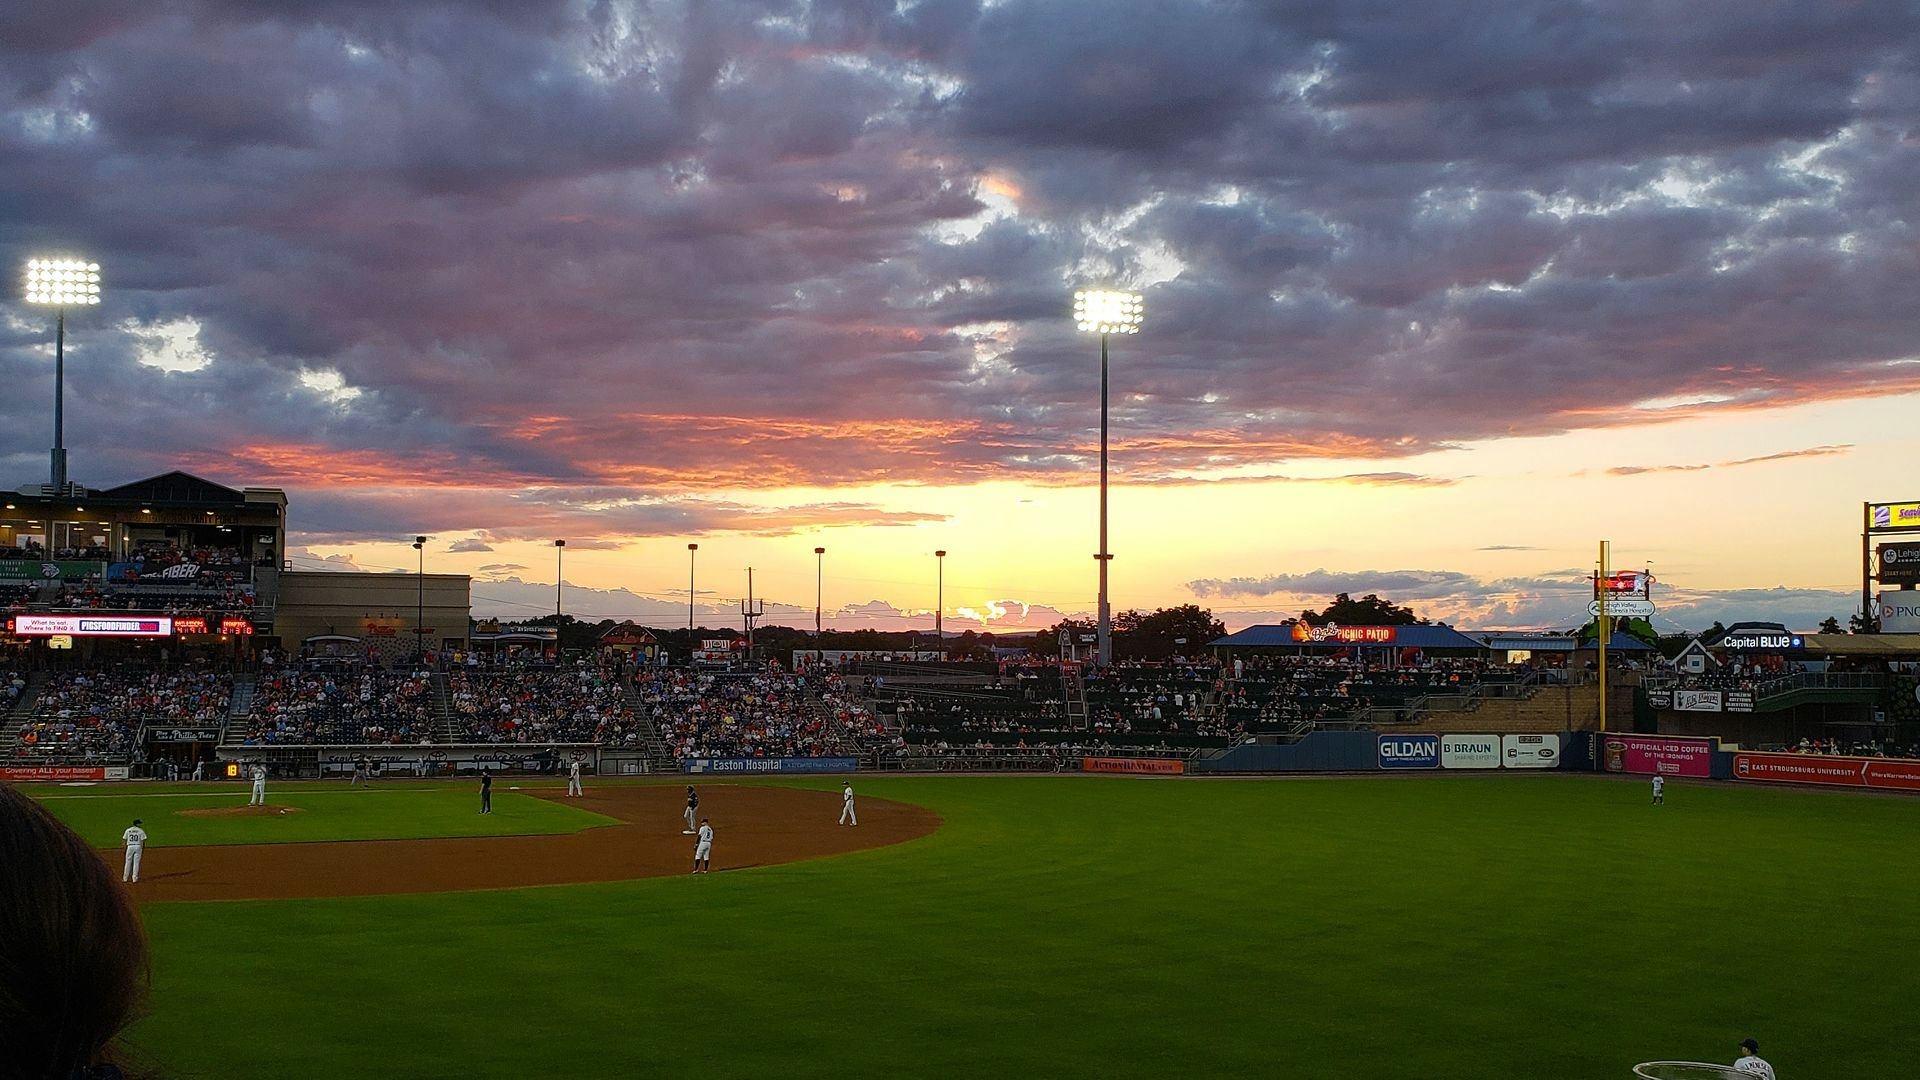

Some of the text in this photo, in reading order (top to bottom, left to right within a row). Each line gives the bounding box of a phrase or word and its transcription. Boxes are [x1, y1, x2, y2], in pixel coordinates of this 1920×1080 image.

[162, 564, 200, 579] FIBER!
[7, 620, 14, 629] 6
[1337, 629, 1363, 639] PICNIC
[1366, 629, 1389, 639] PATIO
[1724, 636, 1759, 649] Capital
[1380, 742, 1436, 757] GILDAN
[1444, 744, 1491, 753] B BRAUN
[1631, 743, 1661, 751] OFFICIAL
[1681, 746, 1709, 754] COFFEE
[713, 760, 782, 772] Easton Hospital
[1769, 765, 1816, 774] STROUDSBURG
[1817, 767, 1856, 776] UNIVERSITY
[129, 834, 138, 842] 30
